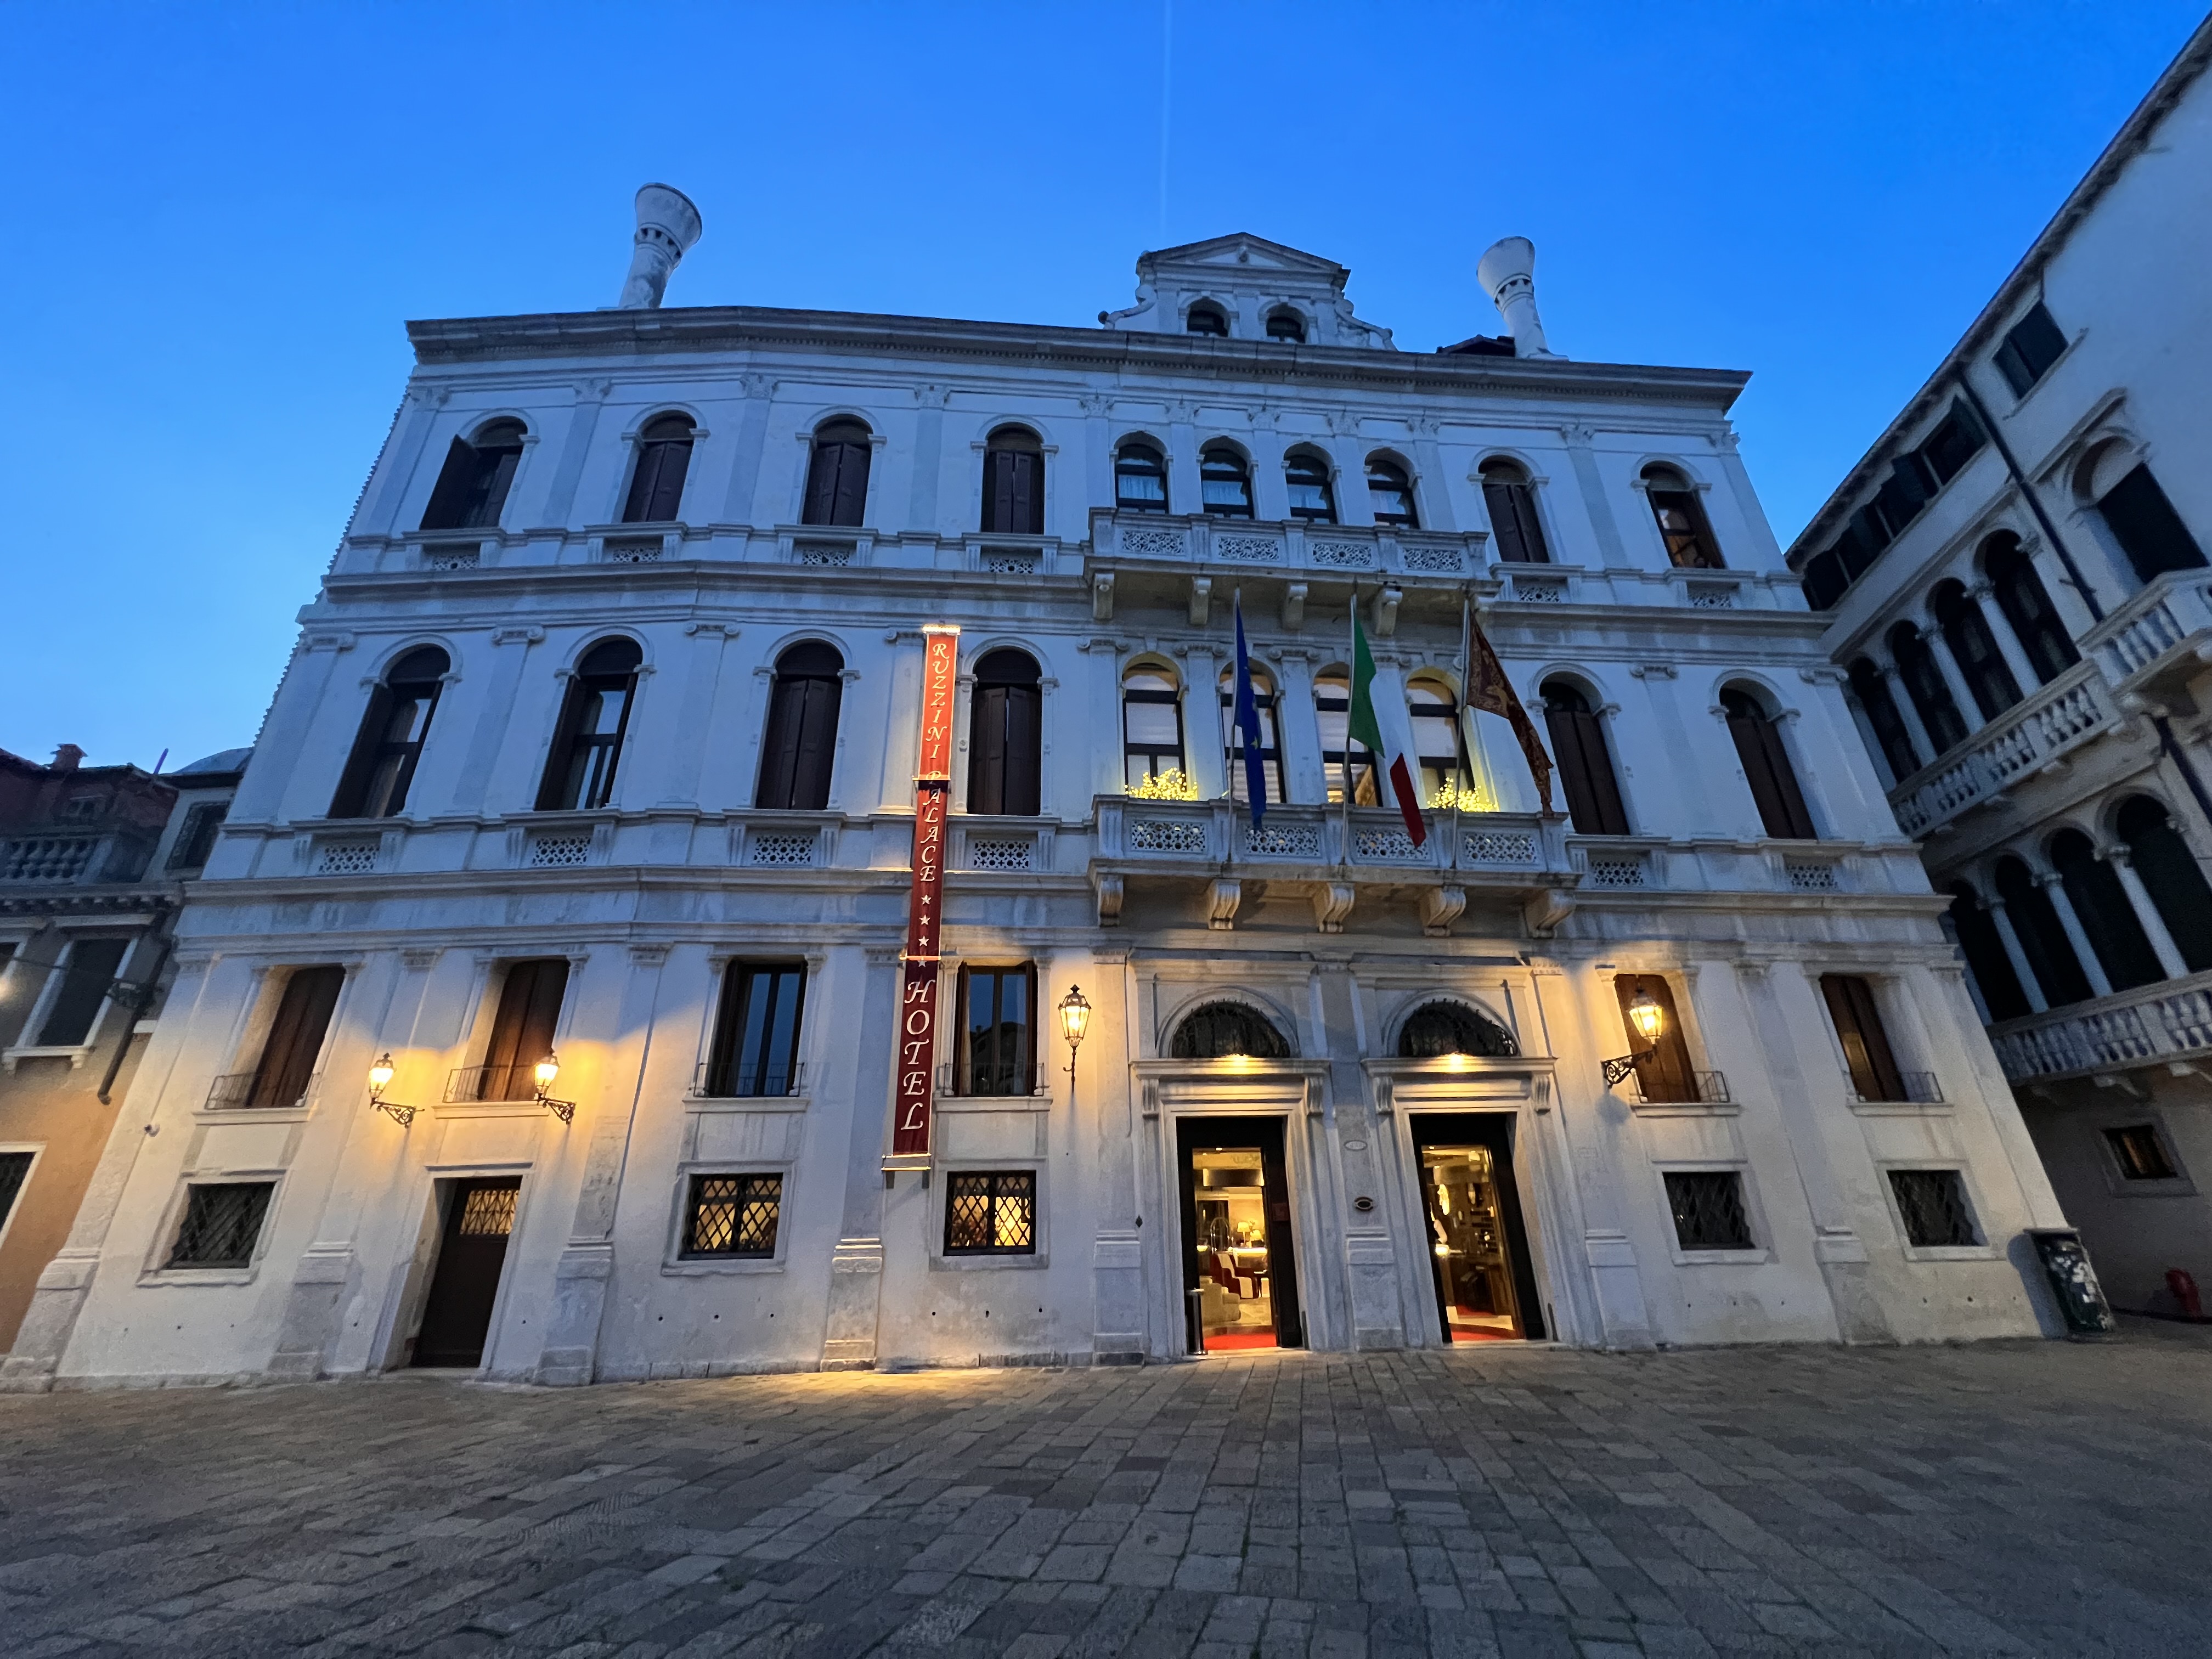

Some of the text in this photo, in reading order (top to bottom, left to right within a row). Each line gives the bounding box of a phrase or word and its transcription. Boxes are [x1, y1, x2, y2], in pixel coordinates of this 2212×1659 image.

[900, 643, 950, 1131] RUZZINI PALACE HOTEL
